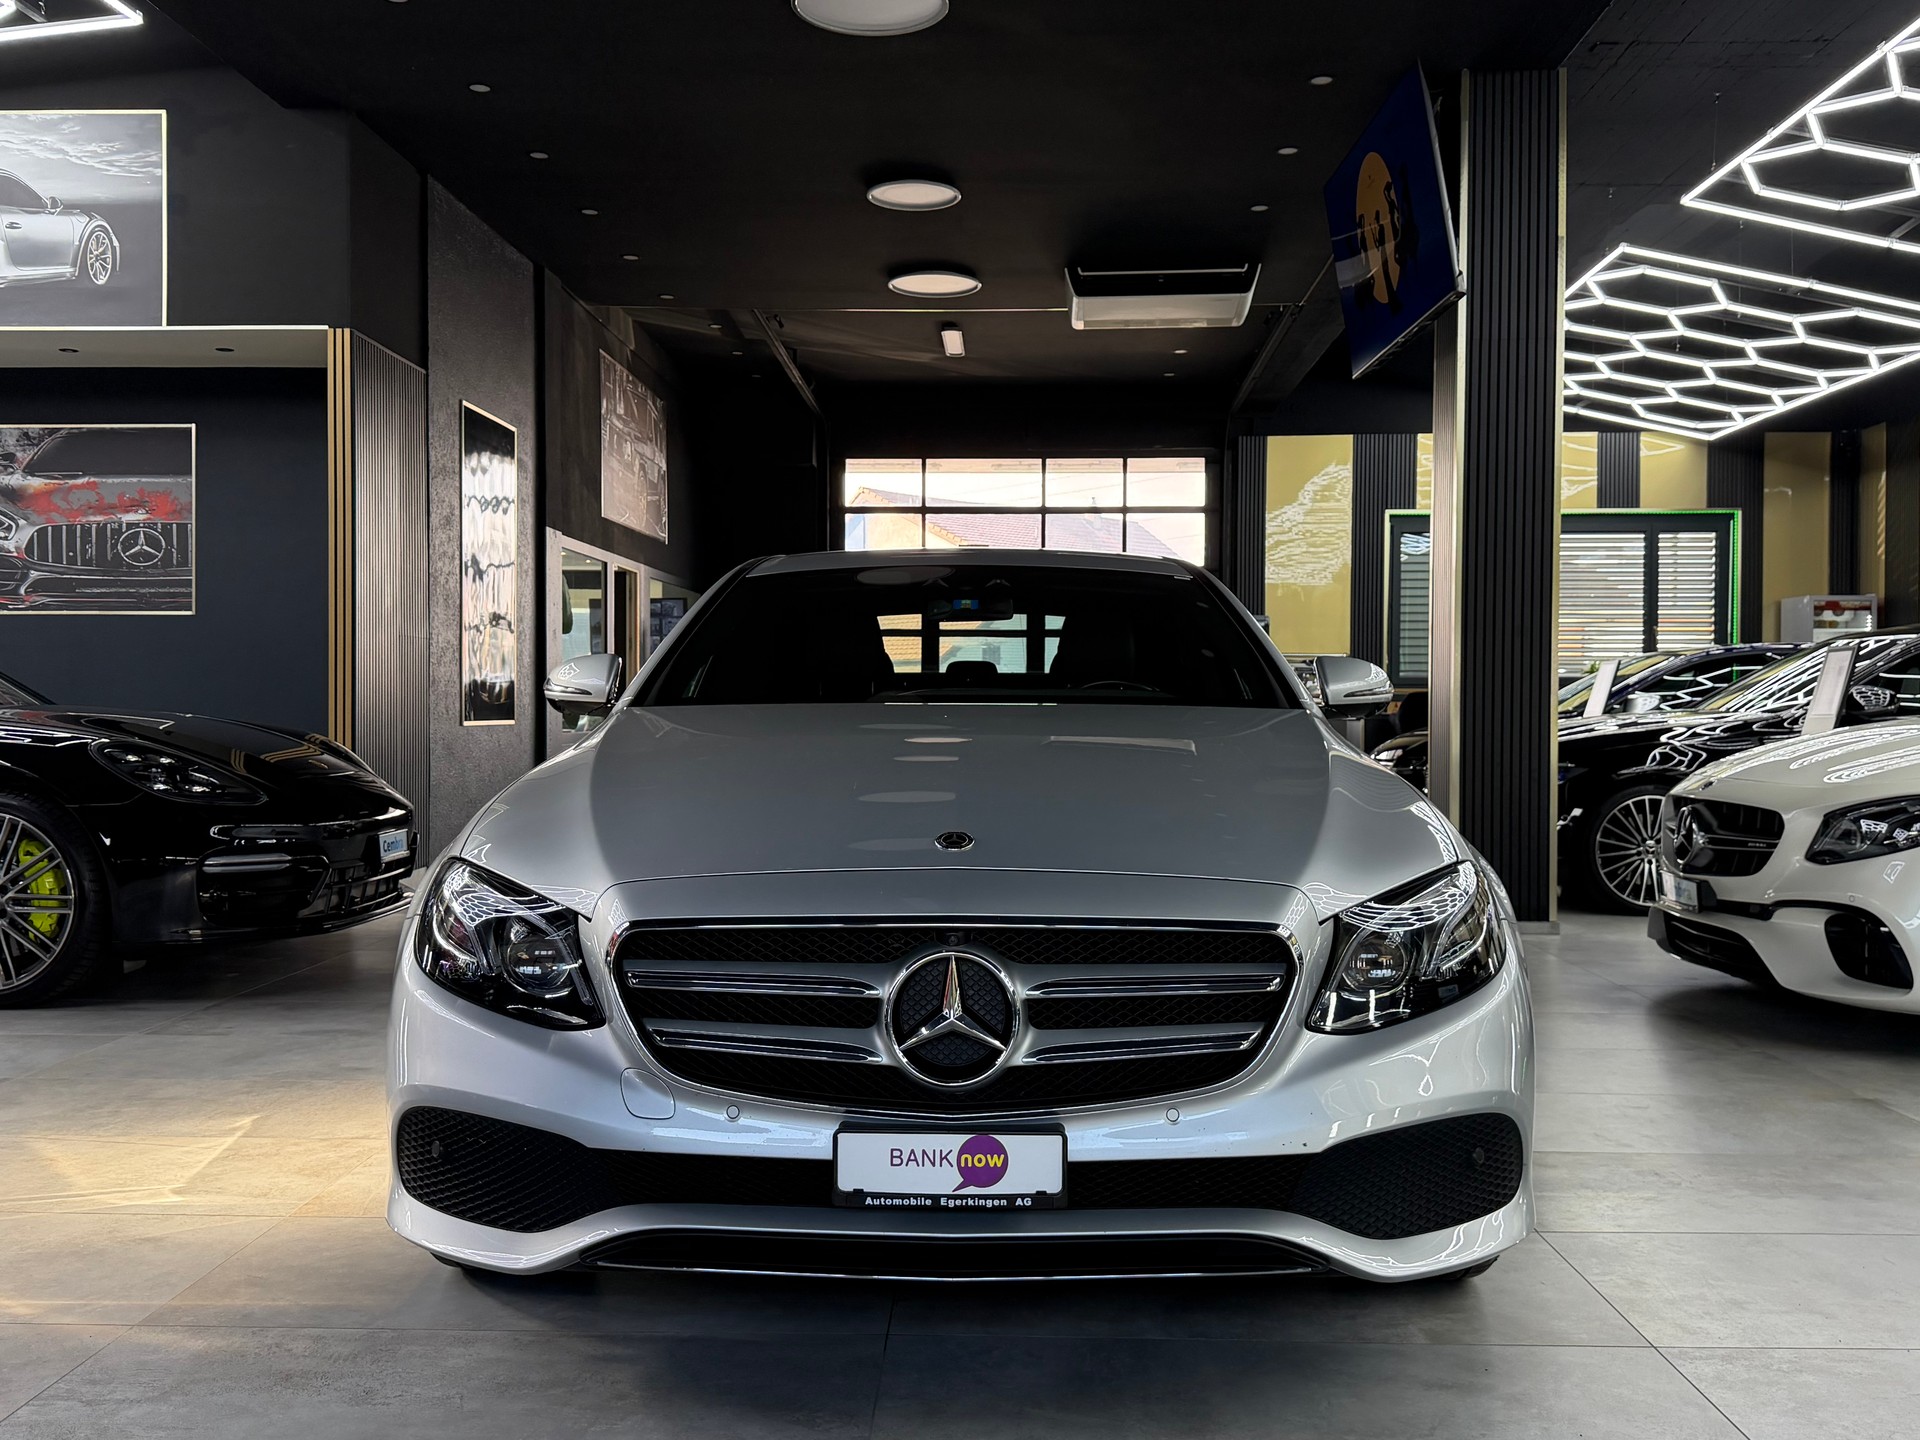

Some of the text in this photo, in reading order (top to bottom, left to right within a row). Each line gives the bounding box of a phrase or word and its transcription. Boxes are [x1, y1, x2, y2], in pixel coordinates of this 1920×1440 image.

[890, 1148, 1005, 1167] BANK now
[865, 1197, 1032, 1207] Automobile Egerkingen AG
